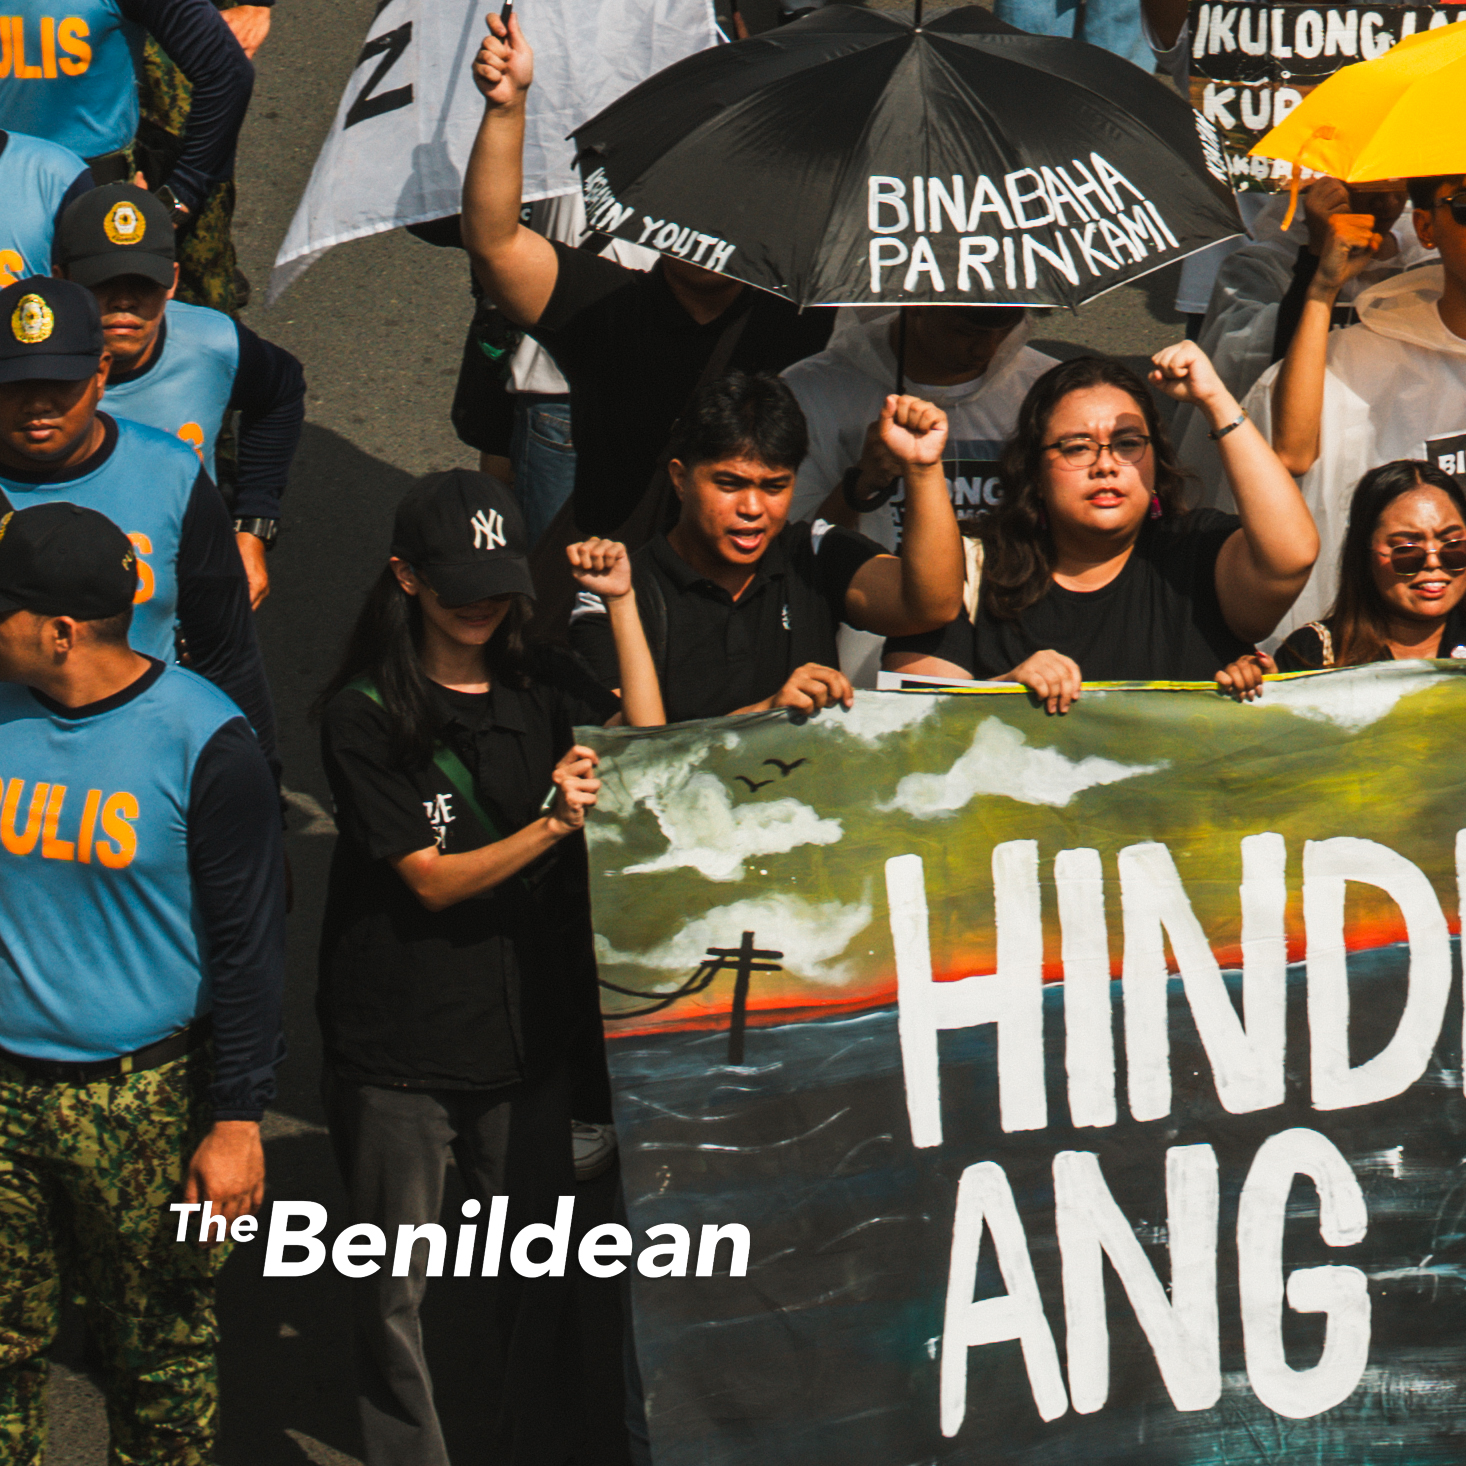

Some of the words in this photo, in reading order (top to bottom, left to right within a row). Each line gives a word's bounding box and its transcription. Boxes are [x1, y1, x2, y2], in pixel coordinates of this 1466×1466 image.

[638, 214, 737, 273] YOUTH
[1069, 200, 1179, 278] KAMI
[938, 1126, 1372, 1442] ANG
